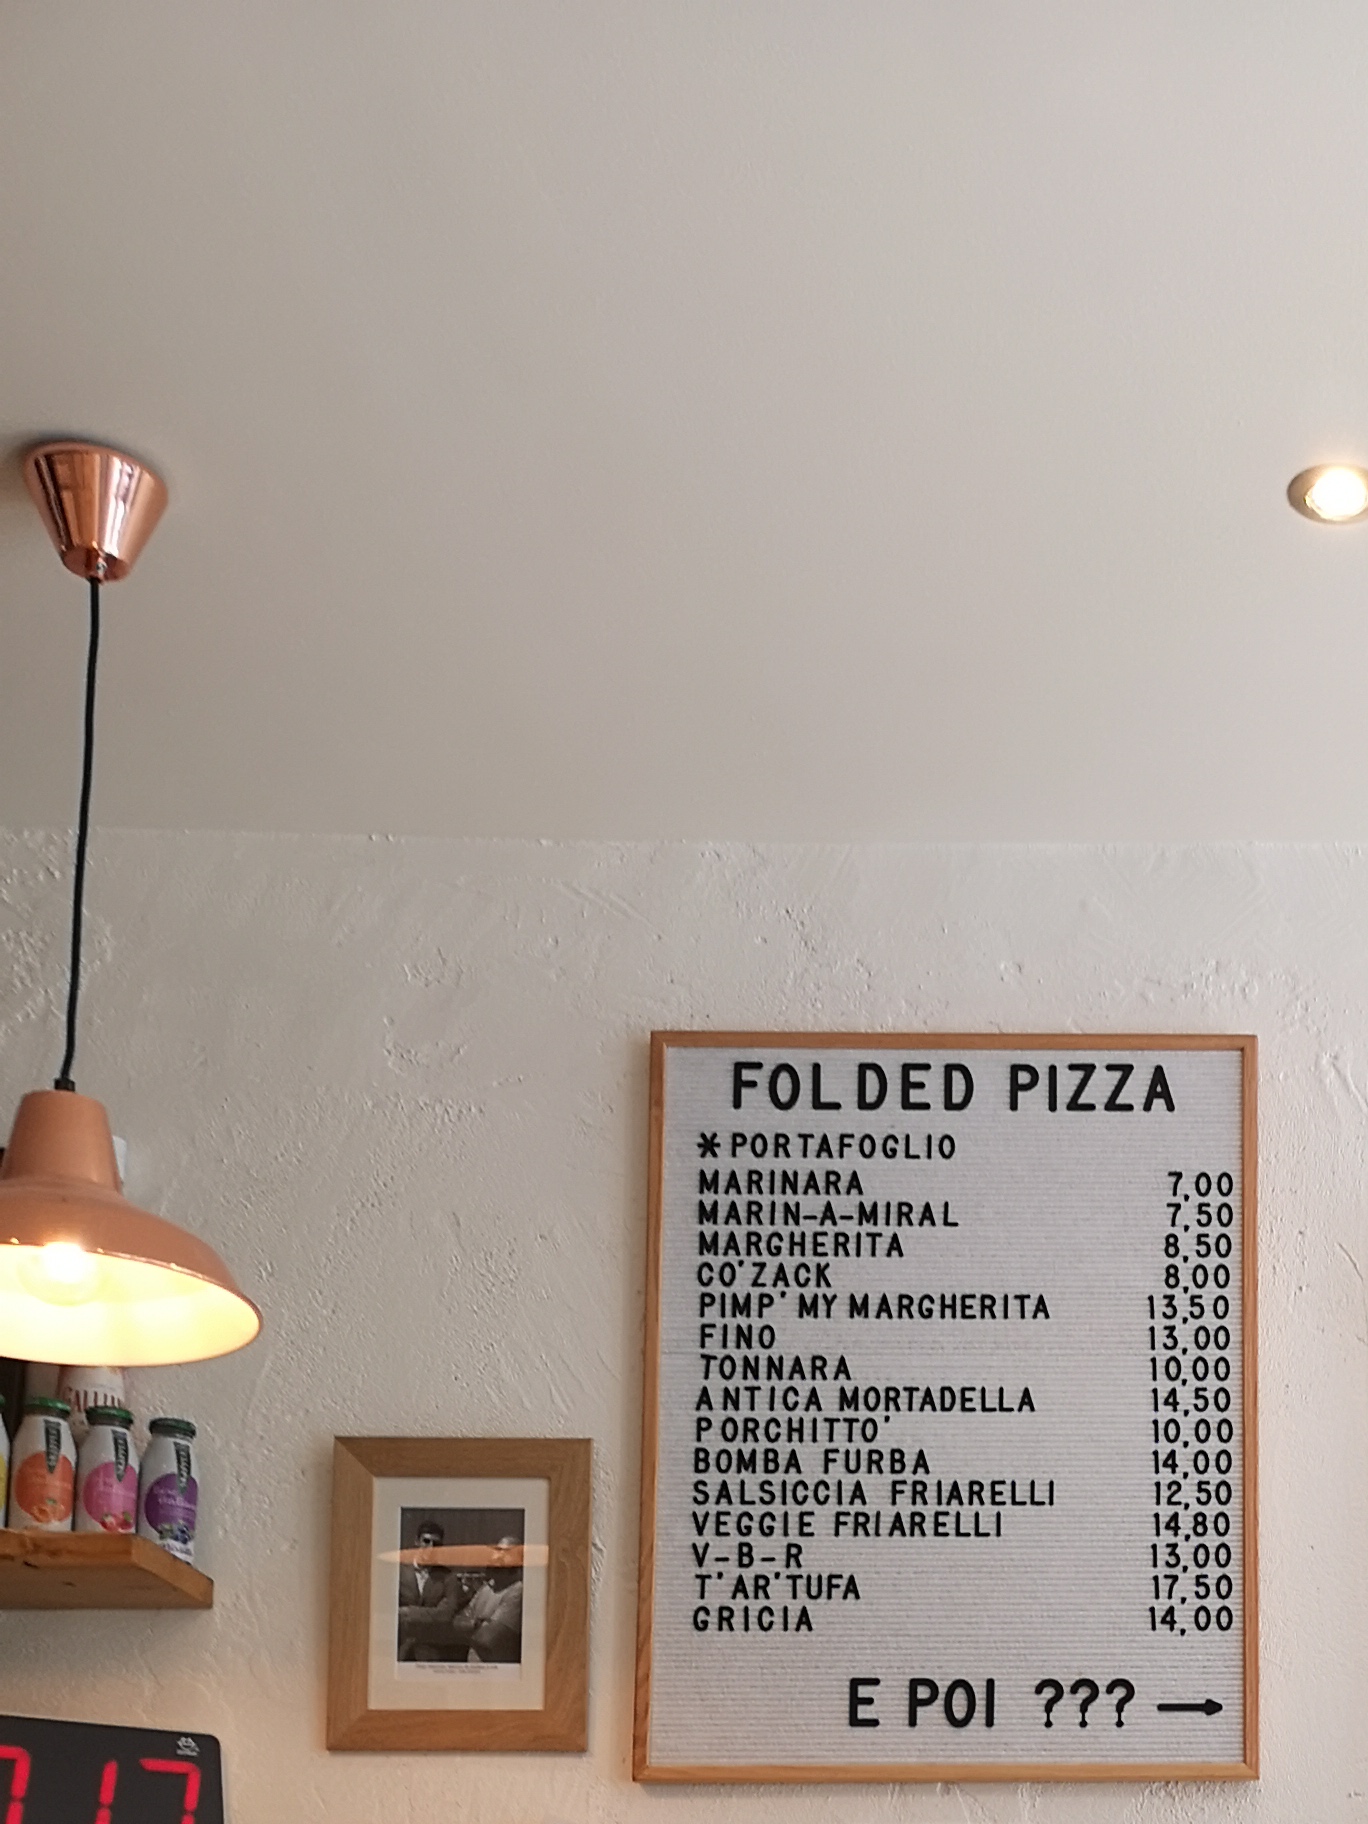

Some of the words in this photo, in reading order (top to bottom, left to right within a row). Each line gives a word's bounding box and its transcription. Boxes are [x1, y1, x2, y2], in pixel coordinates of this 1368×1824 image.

[731, 1060, 974, 1112] FOLDED
[1008, 1062, 1176, 1113] PIZZA
[698, 1168, 864, 1196] MARINARA
[1167, 1170, 1234, 1203] 7,00
[697, 1199, 959, 1228] MARIN-A-MIRAL
[1166, 1202, 1234, 1233] 7,50
[698, 1230, 904, 1258] MARGHERITA
[1163, 1232, 1232, 1264] 8,50
[696, 1259, 832, 1289] CO'ZACK
[1164, 1263, 1231, 1295] 8,00
[699, 1290, 787, 1319] PIMP'
[797, 1292, 838, 1319] MY
[848, 1292, 1050, 1320] MARGHERITA
[1147, 1294, 1230, 1325] 13,50
[699, 1322, 776, 1351] FINO
[1148, 1324, 1231, 1356] 13,00
[699, 1353, 852, 1382] TONNARA
[1149, 1355, 1231, 1387] 10,00
[694, 1385, 823, 1413] ANTICA
[838, 1385, 1036, 1413] MORTADELLA
[1151, 1386, 1231, 1418] 14,50
[1151, 1417, 1234, 1449] 10,00
[693, 1446, 803, 1475] BOMBA
[822, 1447, 931, 1476] FURBA
[1151, 1448, 1233, 1480] 14,00
[692, 1478, 867, 1506] SALSICCIA
[890, 1479, 1055, 1507] FRIARELLI
[1154, 1479, 1233, 1511] 12,50
[691, 1510, 815, 1538] VEGGIE
[833, 1510, 1002, 1538] FRIARELLI
[1152, 1511, 1231, 1543] 14,80
[691, 1541, 803, 1570] V-B-R
[1150, 1542, 1232, 1574] 13,00
[1151, 1573, 1233, 1605] 17,50
[692, 1605, 814, 1633] GRICIA
[1148, 1604, 1234, 1637] 14,00
[848, 1677, 881, 1728] E
[907, 1677, 996, 1729] POI
[1034, 1677, 1136, 1729] ???
